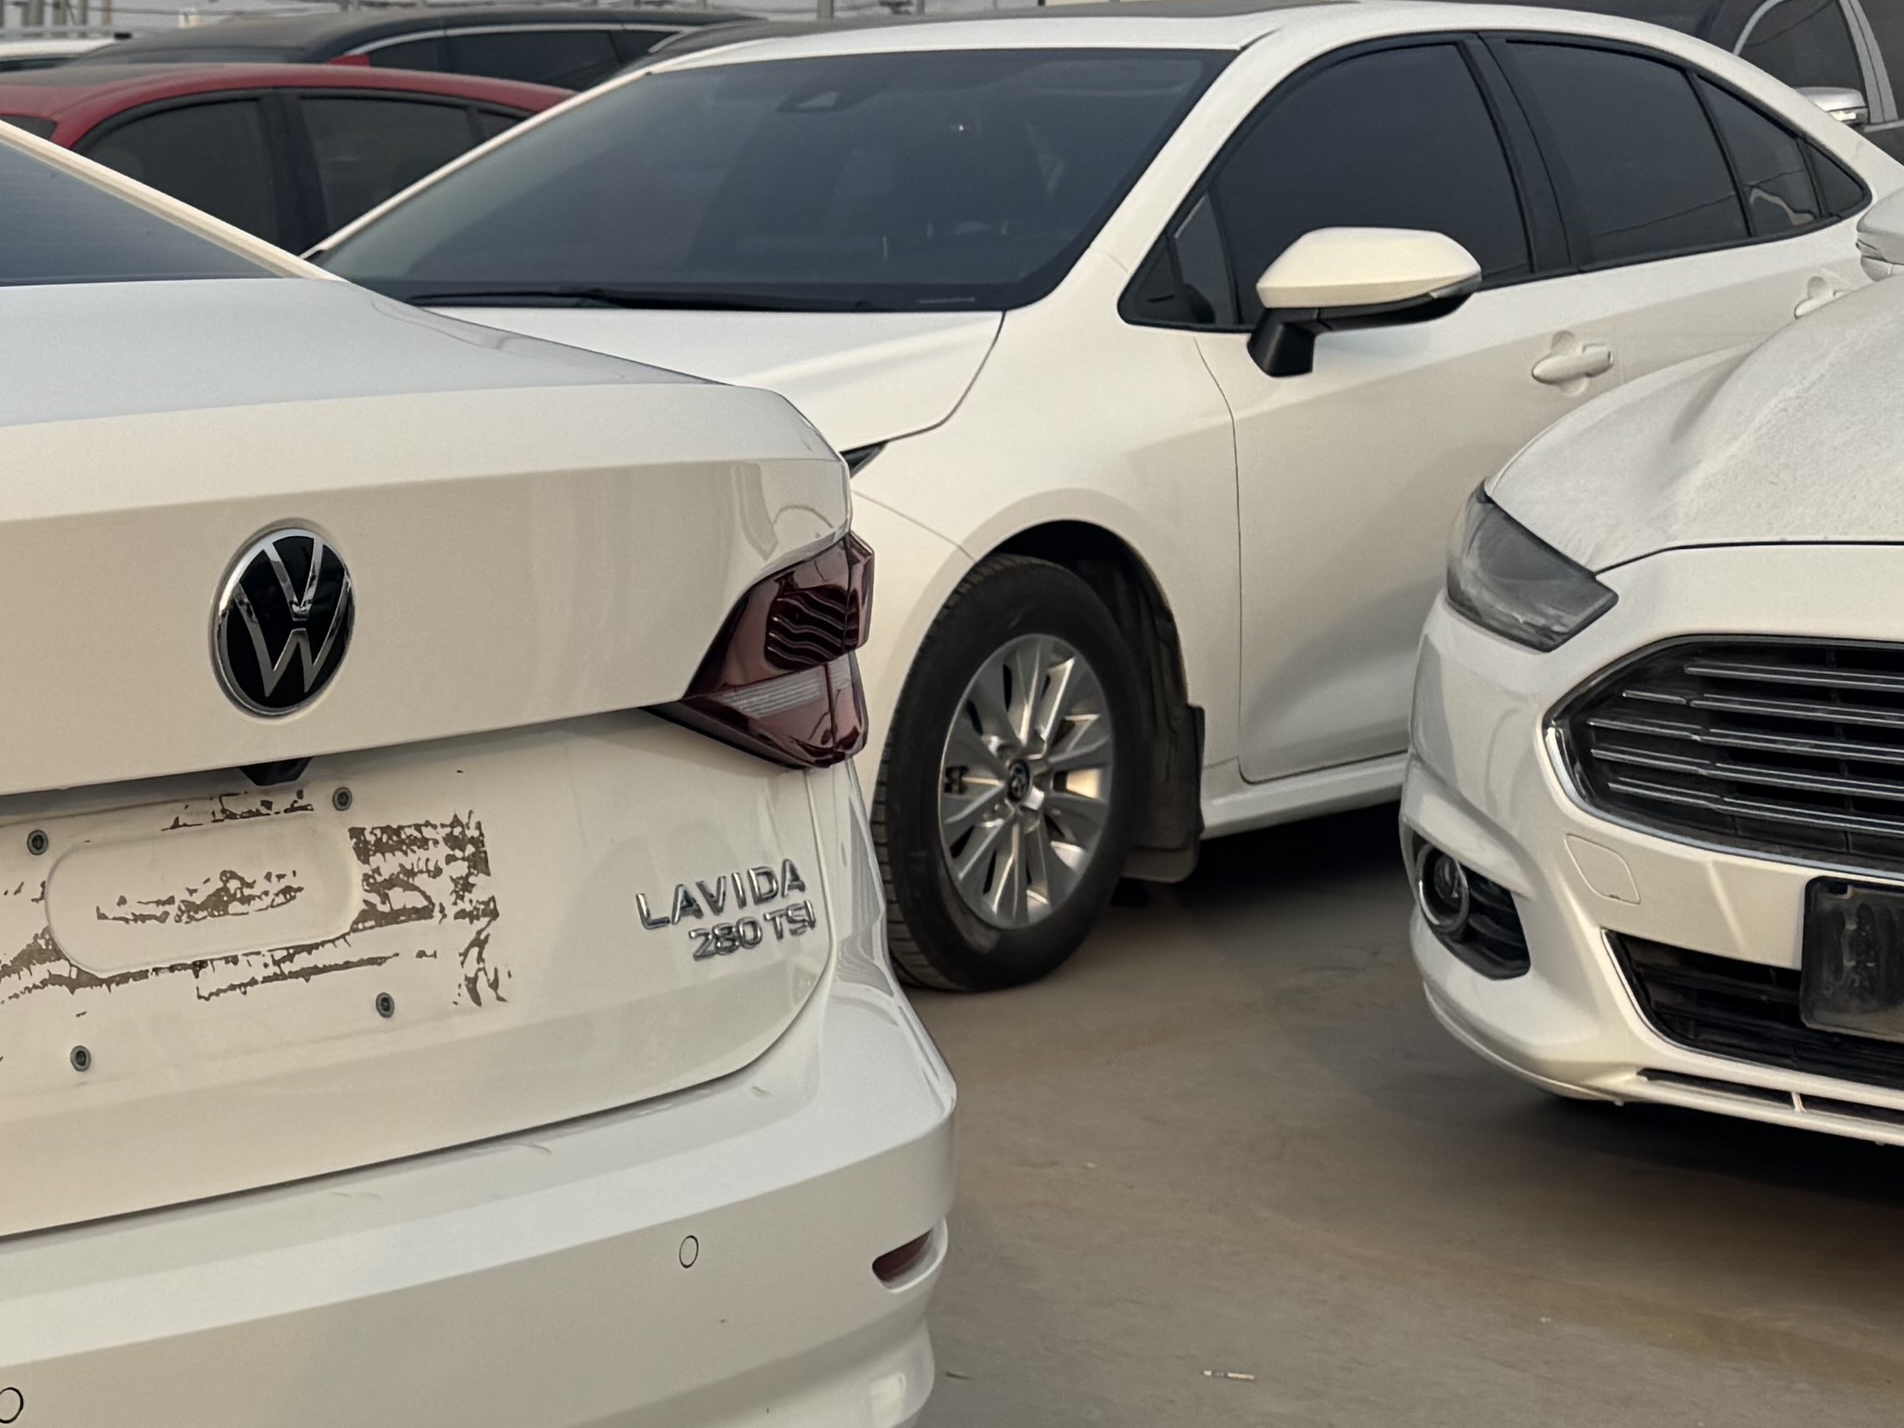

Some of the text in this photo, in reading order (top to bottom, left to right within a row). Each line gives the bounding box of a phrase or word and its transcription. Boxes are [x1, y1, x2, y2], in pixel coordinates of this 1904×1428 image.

[635, 858, 806, 931] LAVIDA
[688, 899, 817, 962] 280 TSI
